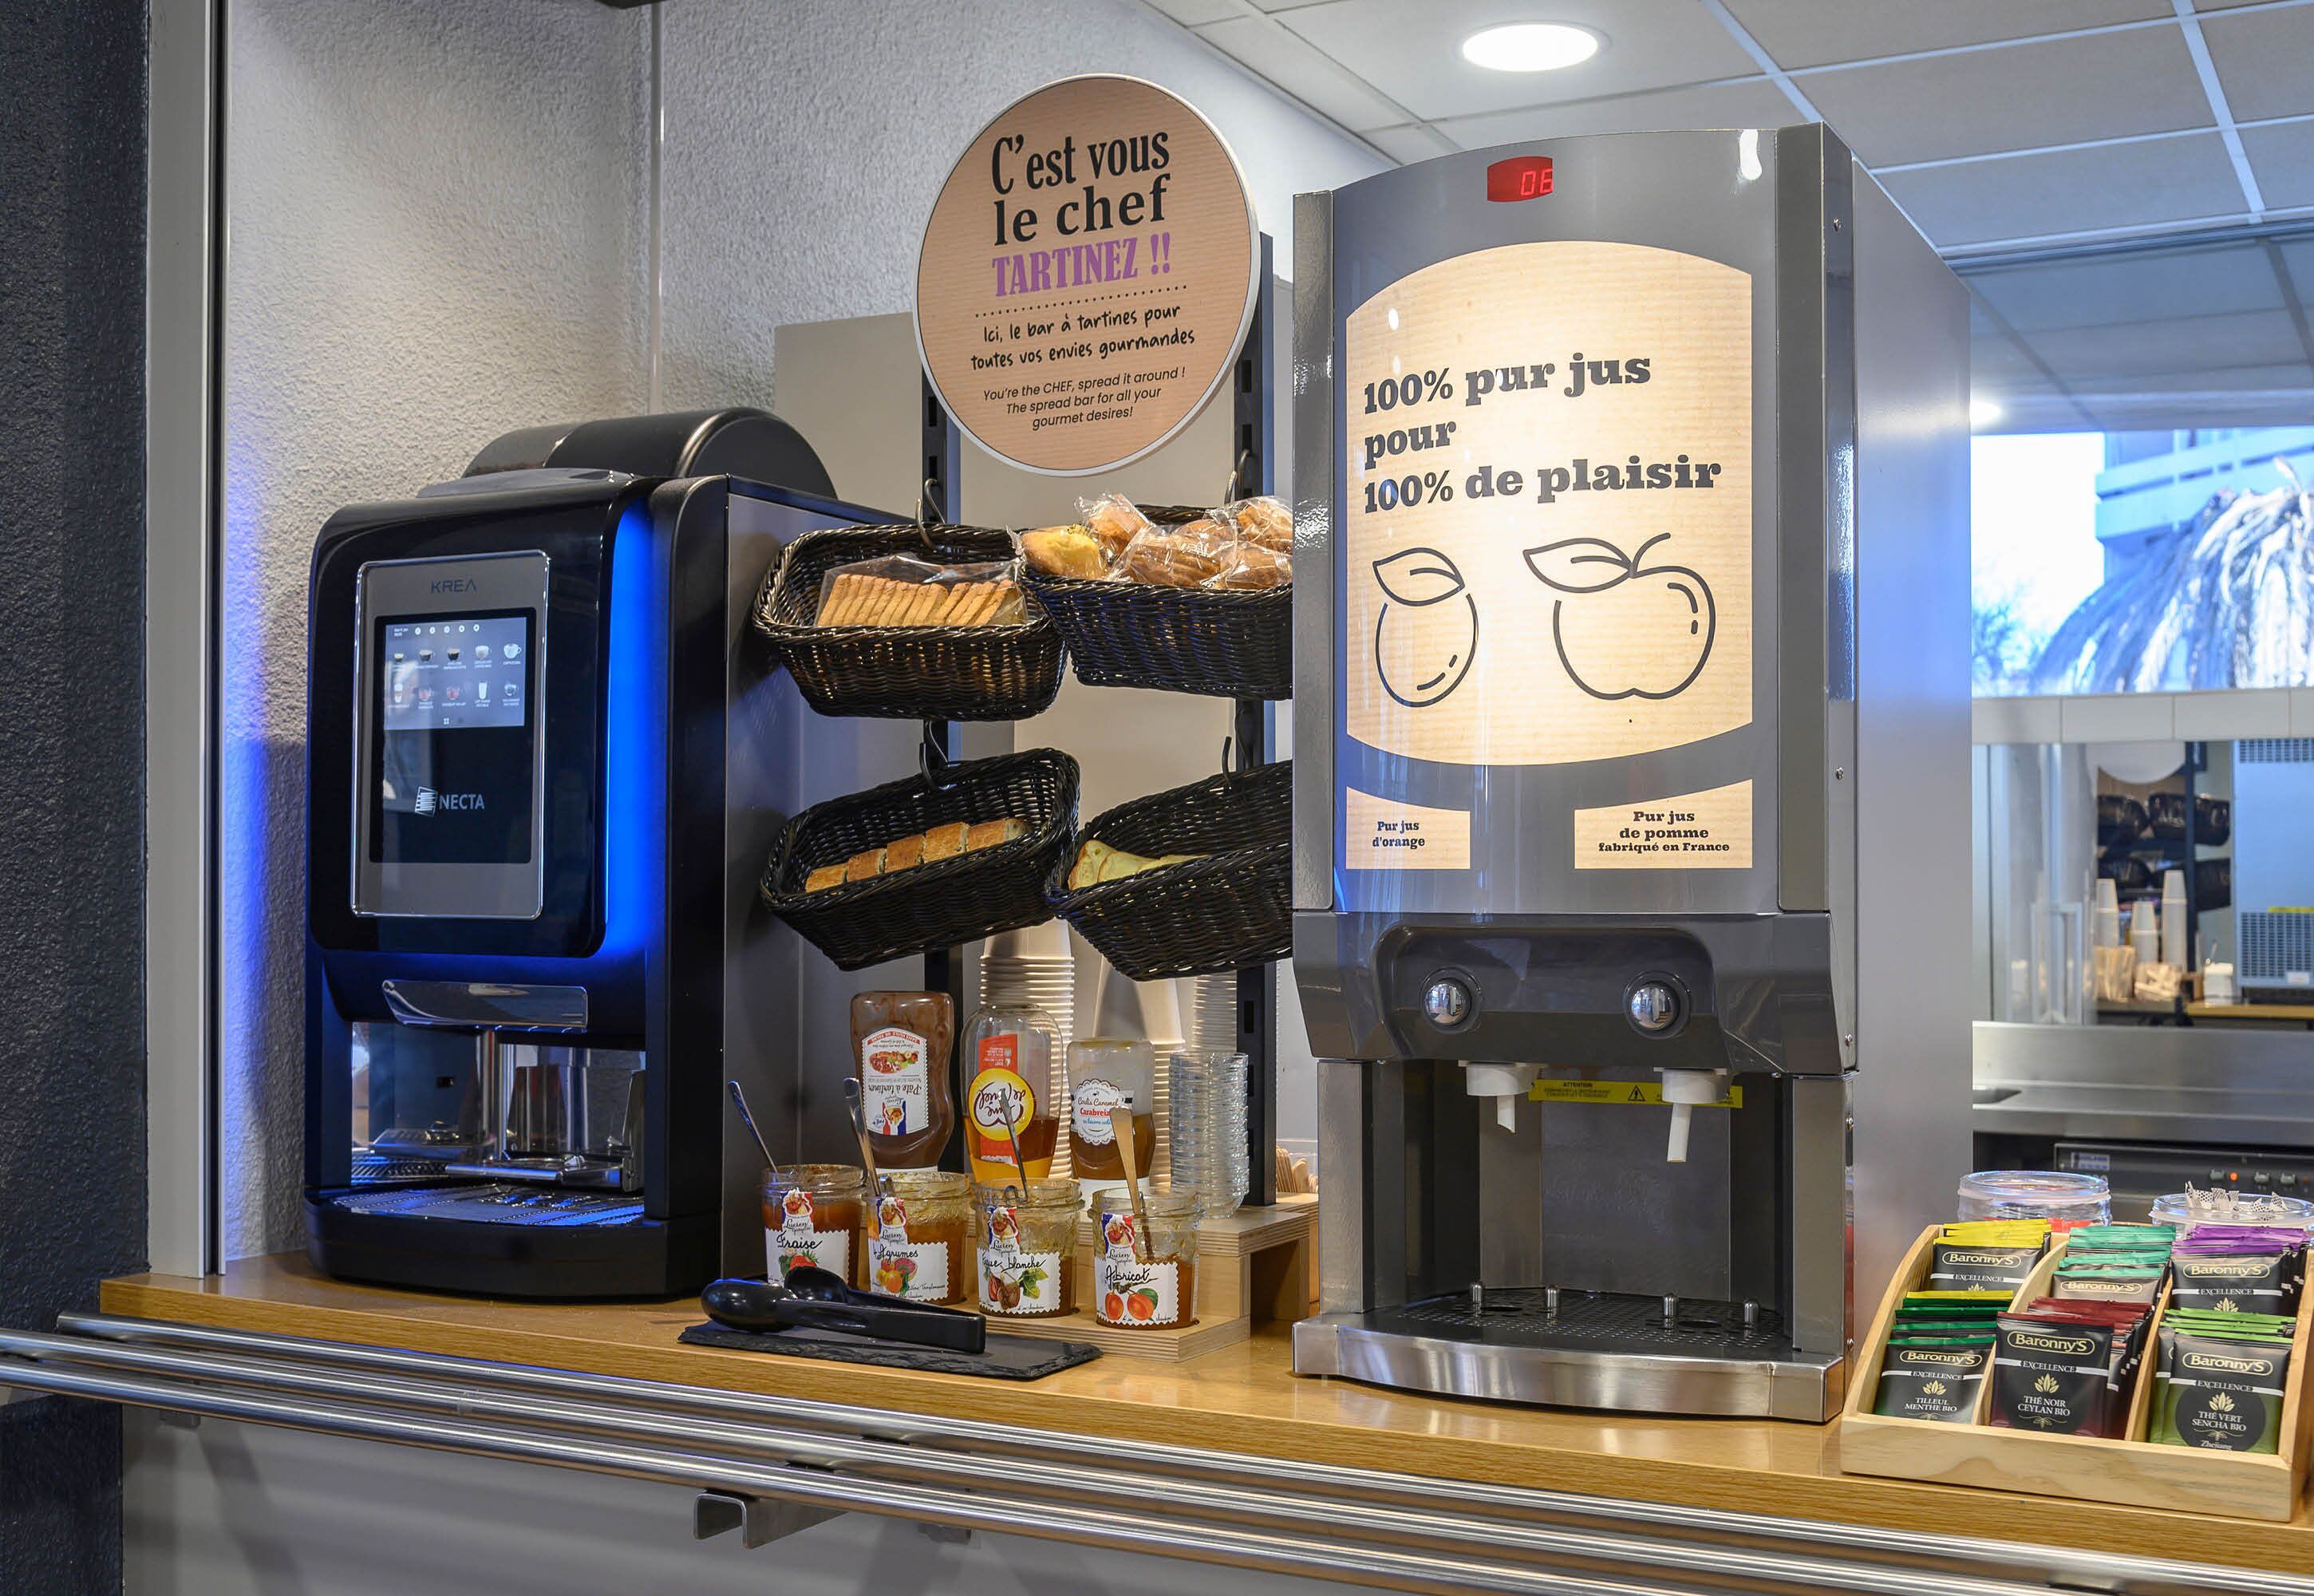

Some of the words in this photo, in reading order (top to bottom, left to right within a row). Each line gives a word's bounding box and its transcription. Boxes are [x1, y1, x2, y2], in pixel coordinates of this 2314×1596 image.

[992, 134, 1076, 195] C'est
[1087, 131, 1171, 180] vous
[993, 200, 1037, 246] le
[1056, 173, 1171, 235] chef
[992, 236, 1139, 297] TARTINEZ
[1150, 231, 1171, 275] !!
[984, 326, 1003, 343] Ici,
[1009, 323, 1021, 339] le
[1028, 322, 1055, 338] bar
[1061, 313, 1071, 332] à
[1078, 310, 1137, 331] tartines
[1144, 306, 1181, 327] pour
[971, 353, 1013, 370] toutes
[1019, 349, 1042, 364] vos
[1048, 342, 1092, 361] envies
[1099, 327, 1195, 359] gourmandes
[984, 388, 1018, 401] You're
[1021, 384, 1040, 397] the
[1043, 380, 1075, 394] CHEF,
[1078, 374, 1119, 393] spread
[1123, 372, 1131, 385] it
[1133, 367, 1179, 383] around
[1182, 366, 1186, 377] !
[1364, 367, 1453, 415] 100%
[1465, 357, 1555, 406] pur
[1564, 352, 1651, 397] jus
[1006, 401, 1027, 414] The
[1029, 397, 1071, 414] spread
[1074, 394, 1094, 407] bar
[1097, 392, 1114, 405] for
[1116, 389, 1131, 402] all
[1134, 387, 1161, 405] your
[1033, 413, 1084, 431] gourmet
[1086, 406, 1133, 421] desires!
[1364, 421, 1457, 470] pour
[1364, 469, 1453, 514] 100%
[1465, 465, 1523, 499] de
[1537, 454, 1722, 504] plaisir
[439, 794, 485, 811] NECTA
[1633, 811, 1664, 823] Pur
[1667, 810, 1695, 824] jus
[1376, 821, 1398, 832] Pur
[1400, 820, 1420, 833] jus
[1619, 827, 1641, 839] de
[1644, 828, 1708, 841] pomme
[1372, 836, 1425, 850] d'orange
[1598, 842, 1660, 855] fabriqué
[1662, 843, 1680, 852] en
[1682, 842, 1730, 852] France
[868, 1084, 894, 1096] tartiner
[895, 1085, 901, 1095] à
[902, 1084, 922, 1096] Pâte
[1013, 1089, 1026, 1104] de
[1093, 1098, 1119, 1107] Caramel
[776, 1231, 823, 1249] Fraise
[875, 1244, 918, 1265] Agrumes
[1107, 1249, 1130, 1260] Lucien
[1001, 1256, 1047, 1273] blanche
[1105, 1265, 1151, 1290] Abricot
[1955, 1274, 2003, 1283] EXCELLENCE
[2023, 1361, 2075, 1373] EXCELLENCE
[1913, 1371, 1963, 1381] EXCELLENCE
[2198, 1381, 2253, 1393] EXCELLENCE
[1905, 1403, 1941, 1412] MENTHE
[2024, 1395, 2043, 1405] THÉ
[2044, 1398, 2066, 1408] NOIR
[2017, 1404, 2053, 1415] CEYLAN
[2054, 1407, 2071, 1416] BIO
[2198, 1410, 2217, 1420] THÉ
[2219, 1413, 2243, 1423] VERT
[2192, 1419, 2227, 1429] SENCHA
[2229, 1422, 2247, 1432] BIO
